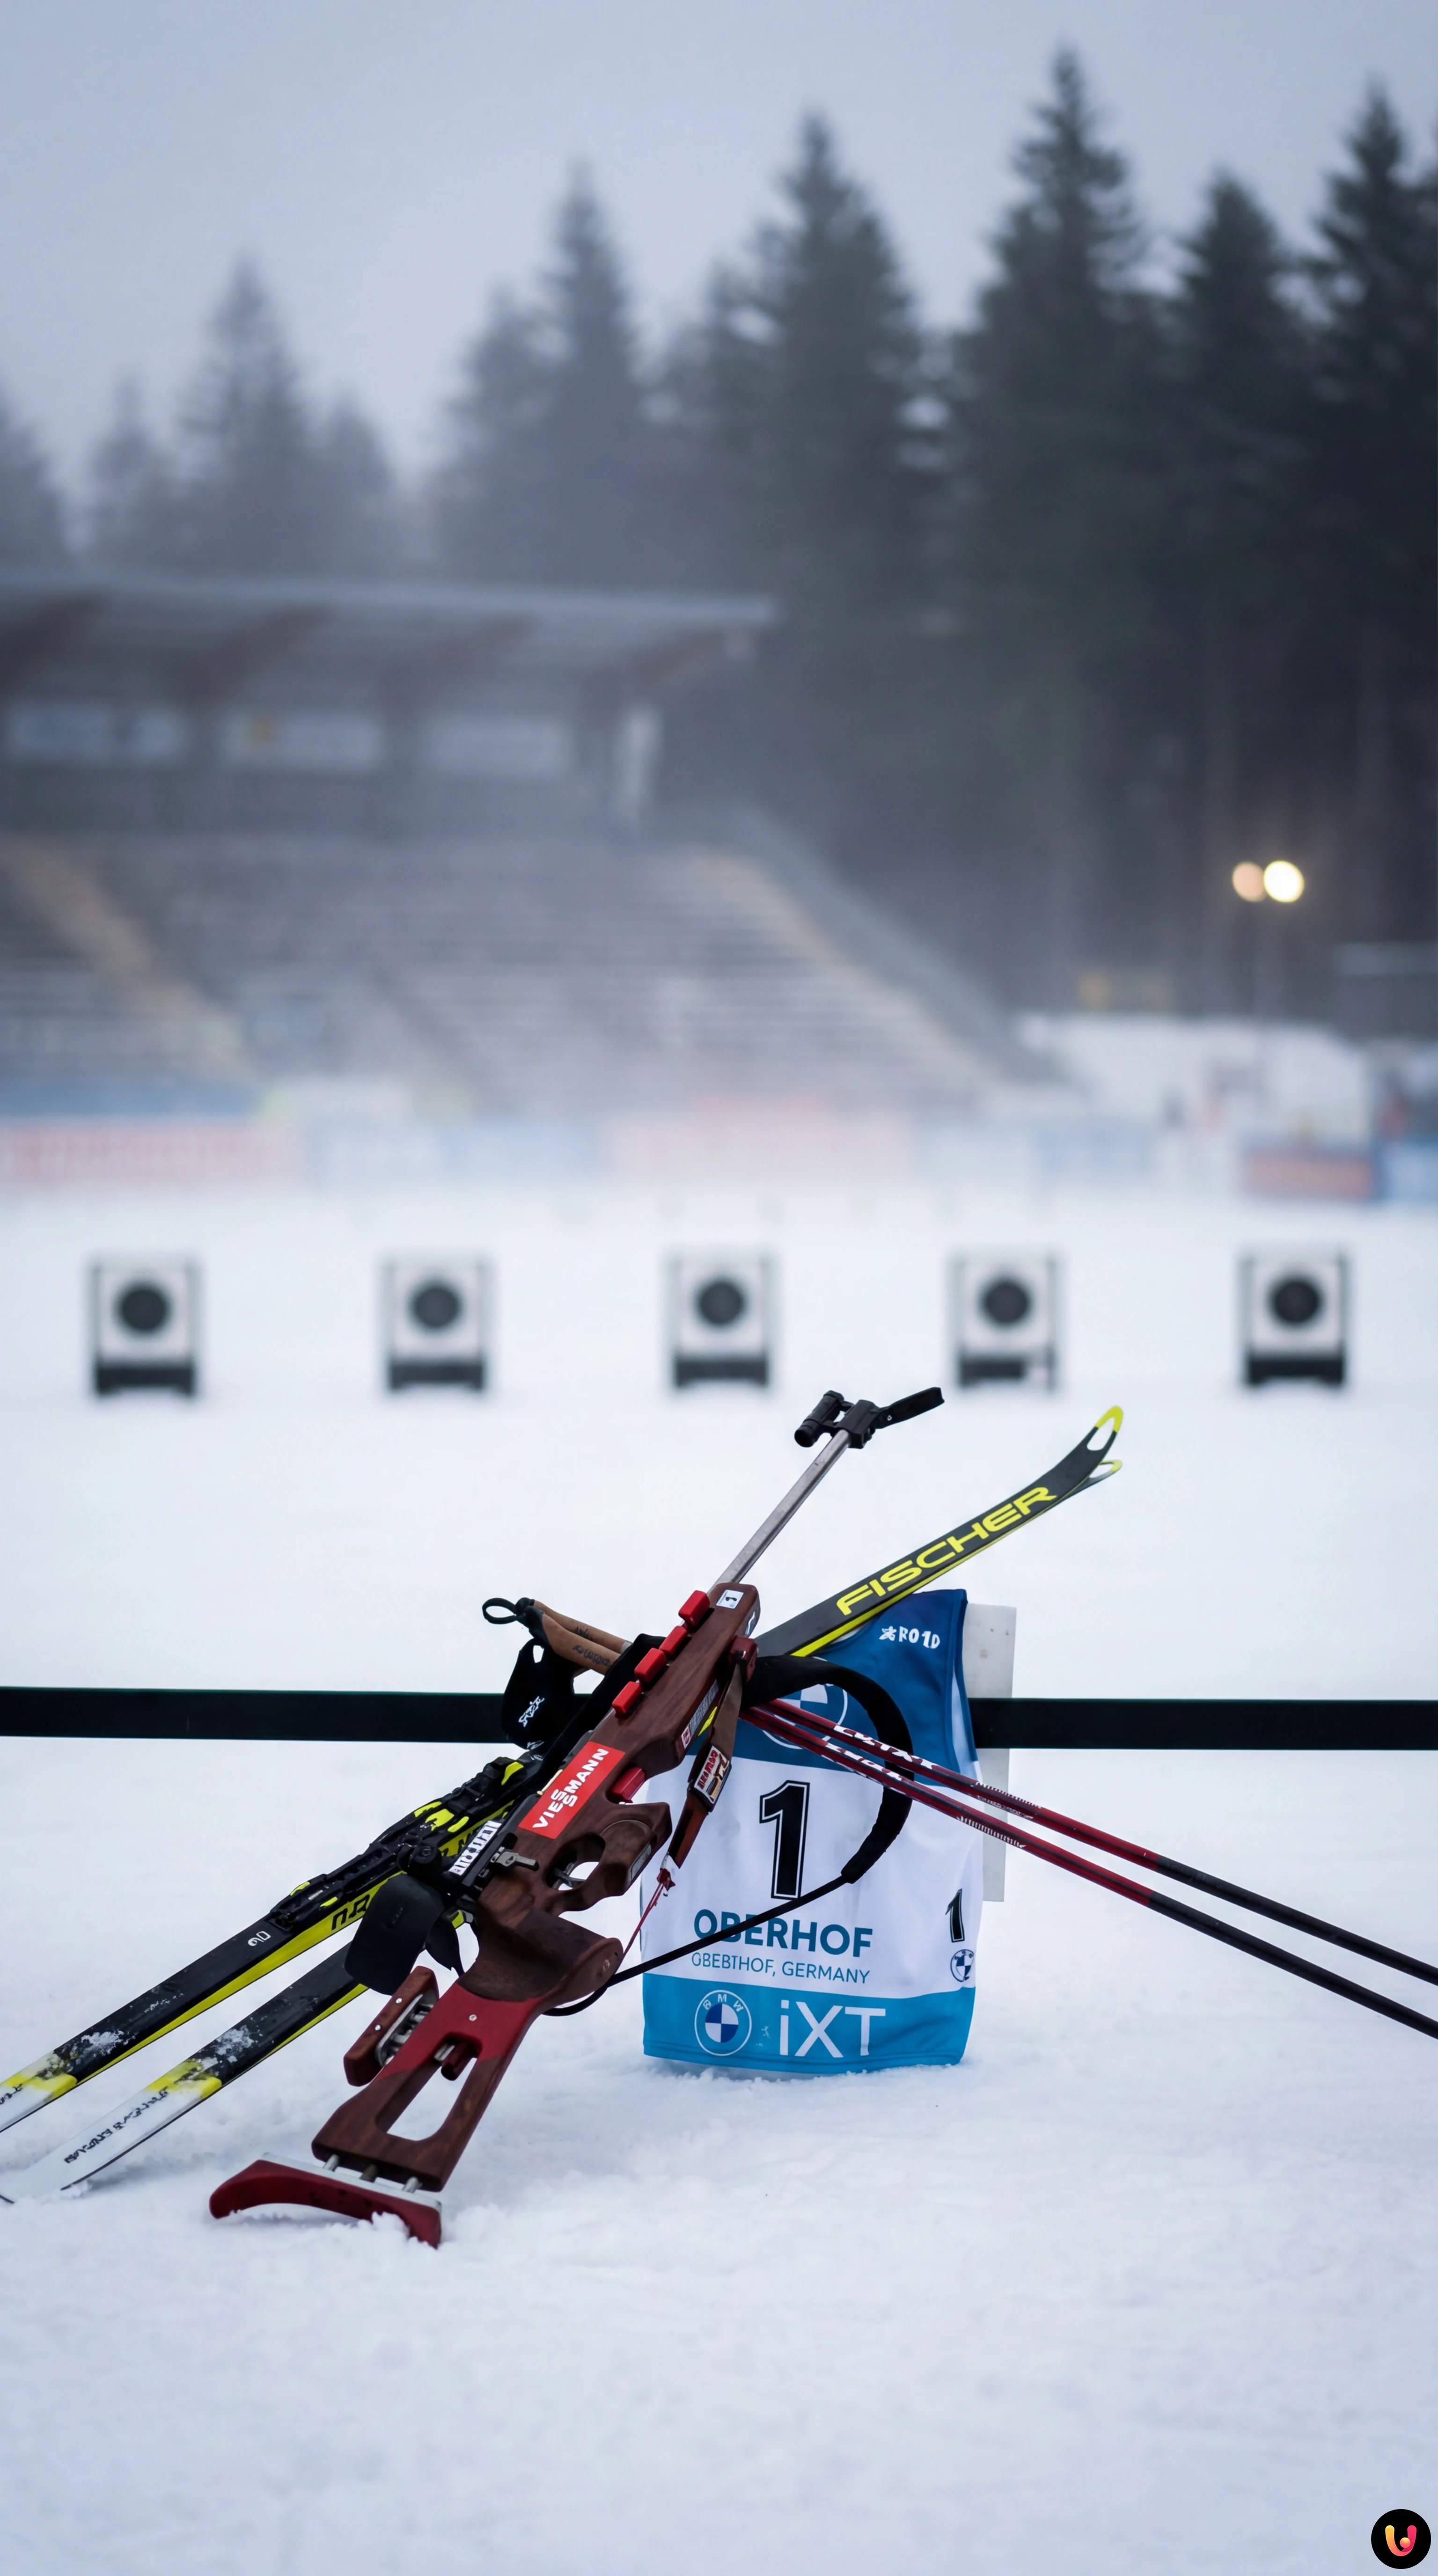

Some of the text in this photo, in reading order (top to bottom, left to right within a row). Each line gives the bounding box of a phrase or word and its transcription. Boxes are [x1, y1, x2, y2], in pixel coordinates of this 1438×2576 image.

[836, 1486, 1057, 1616] FISCHER
[759, 1780, 810, 1899] 1
[694, 1909, 873, 1958] OBERHOF
[945, 1888, 965, 1943] 1
[782, 1961, 870, 1984] GERMANY
[779, 1999, 886, 2058] iXT
